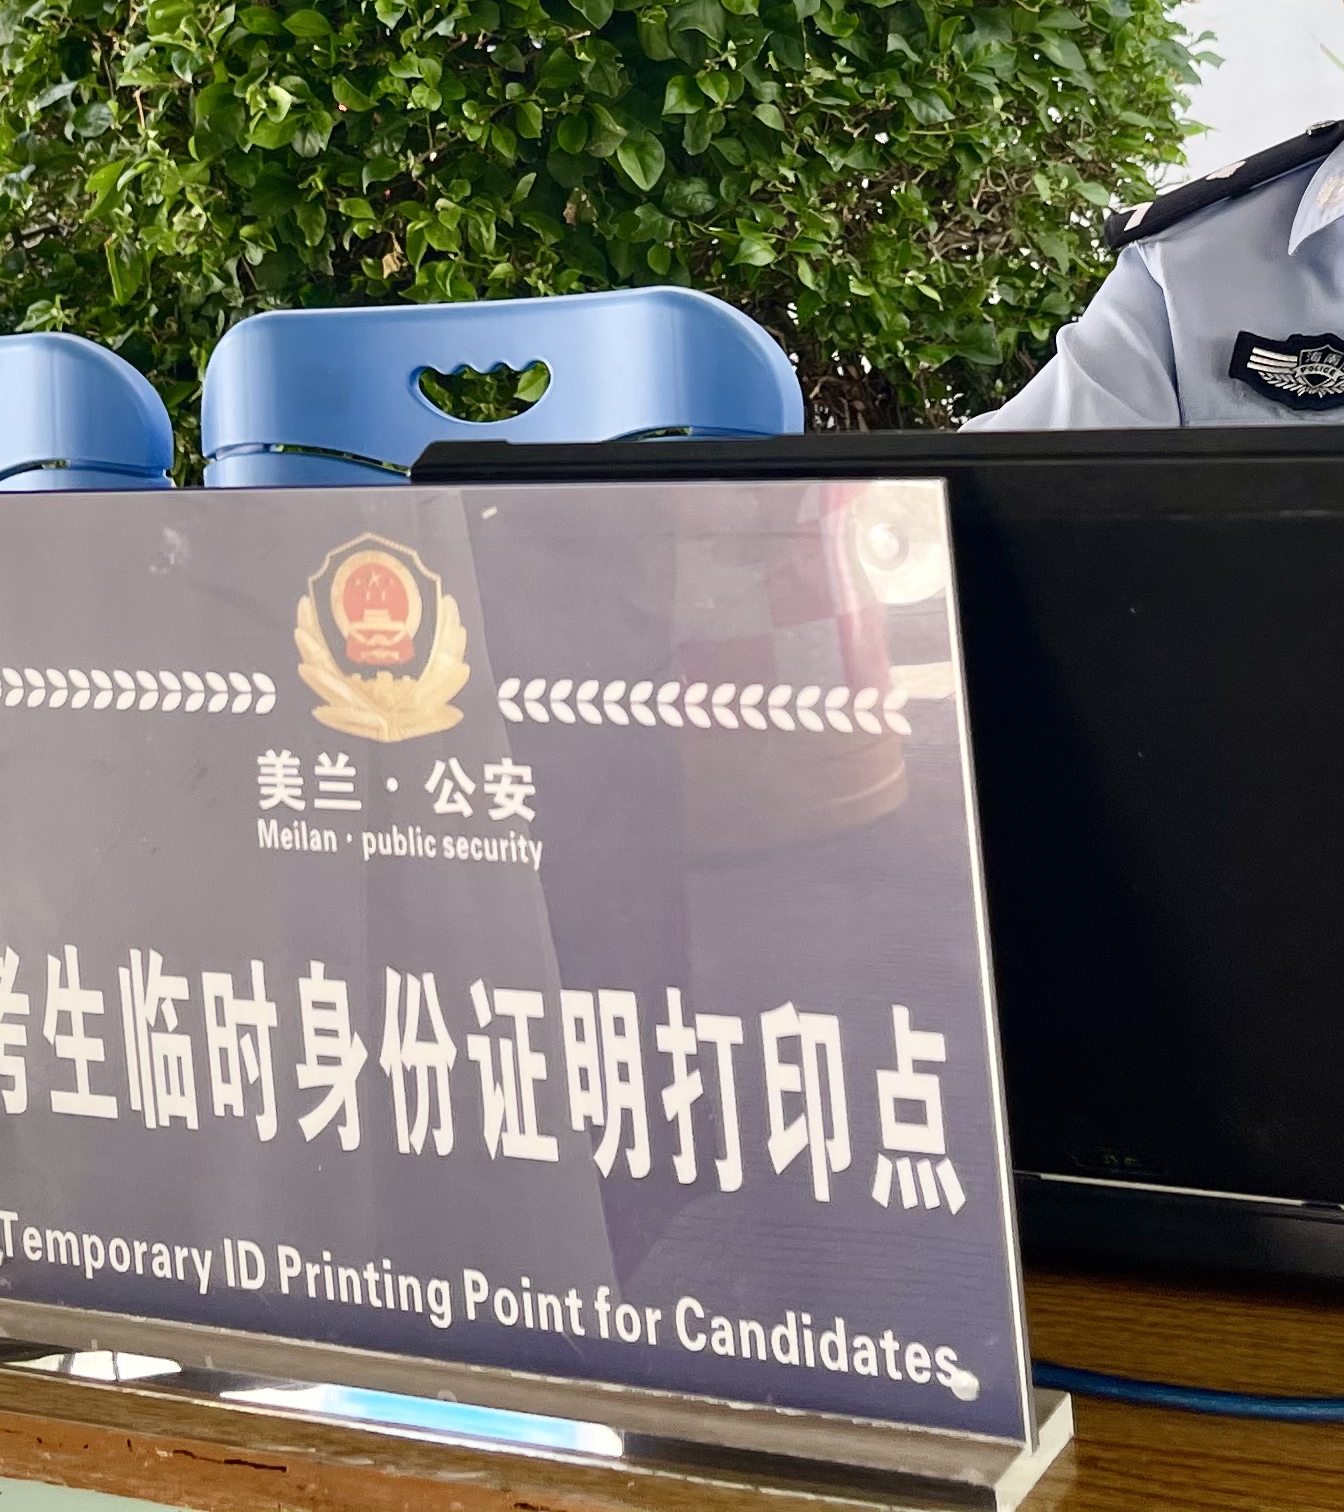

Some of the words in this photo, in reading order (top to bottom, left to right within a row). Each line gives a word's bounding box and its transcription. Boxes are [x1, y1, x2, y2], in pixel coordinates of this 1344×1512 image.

[1300, 364, 1337, 377] POLICE
[257, 818, 338, 853] Meilan
[362, 824, 437, 861] public
[443, 830, 543, 871] security
[223, 1237, 267, 1290] ID
[277, 1244, 452, 1329] Printing
[463, 1268, 586, 1337] Point
[594, 1285, 662, 1345] for
[675, 1295, 959, 1387] Candidates
